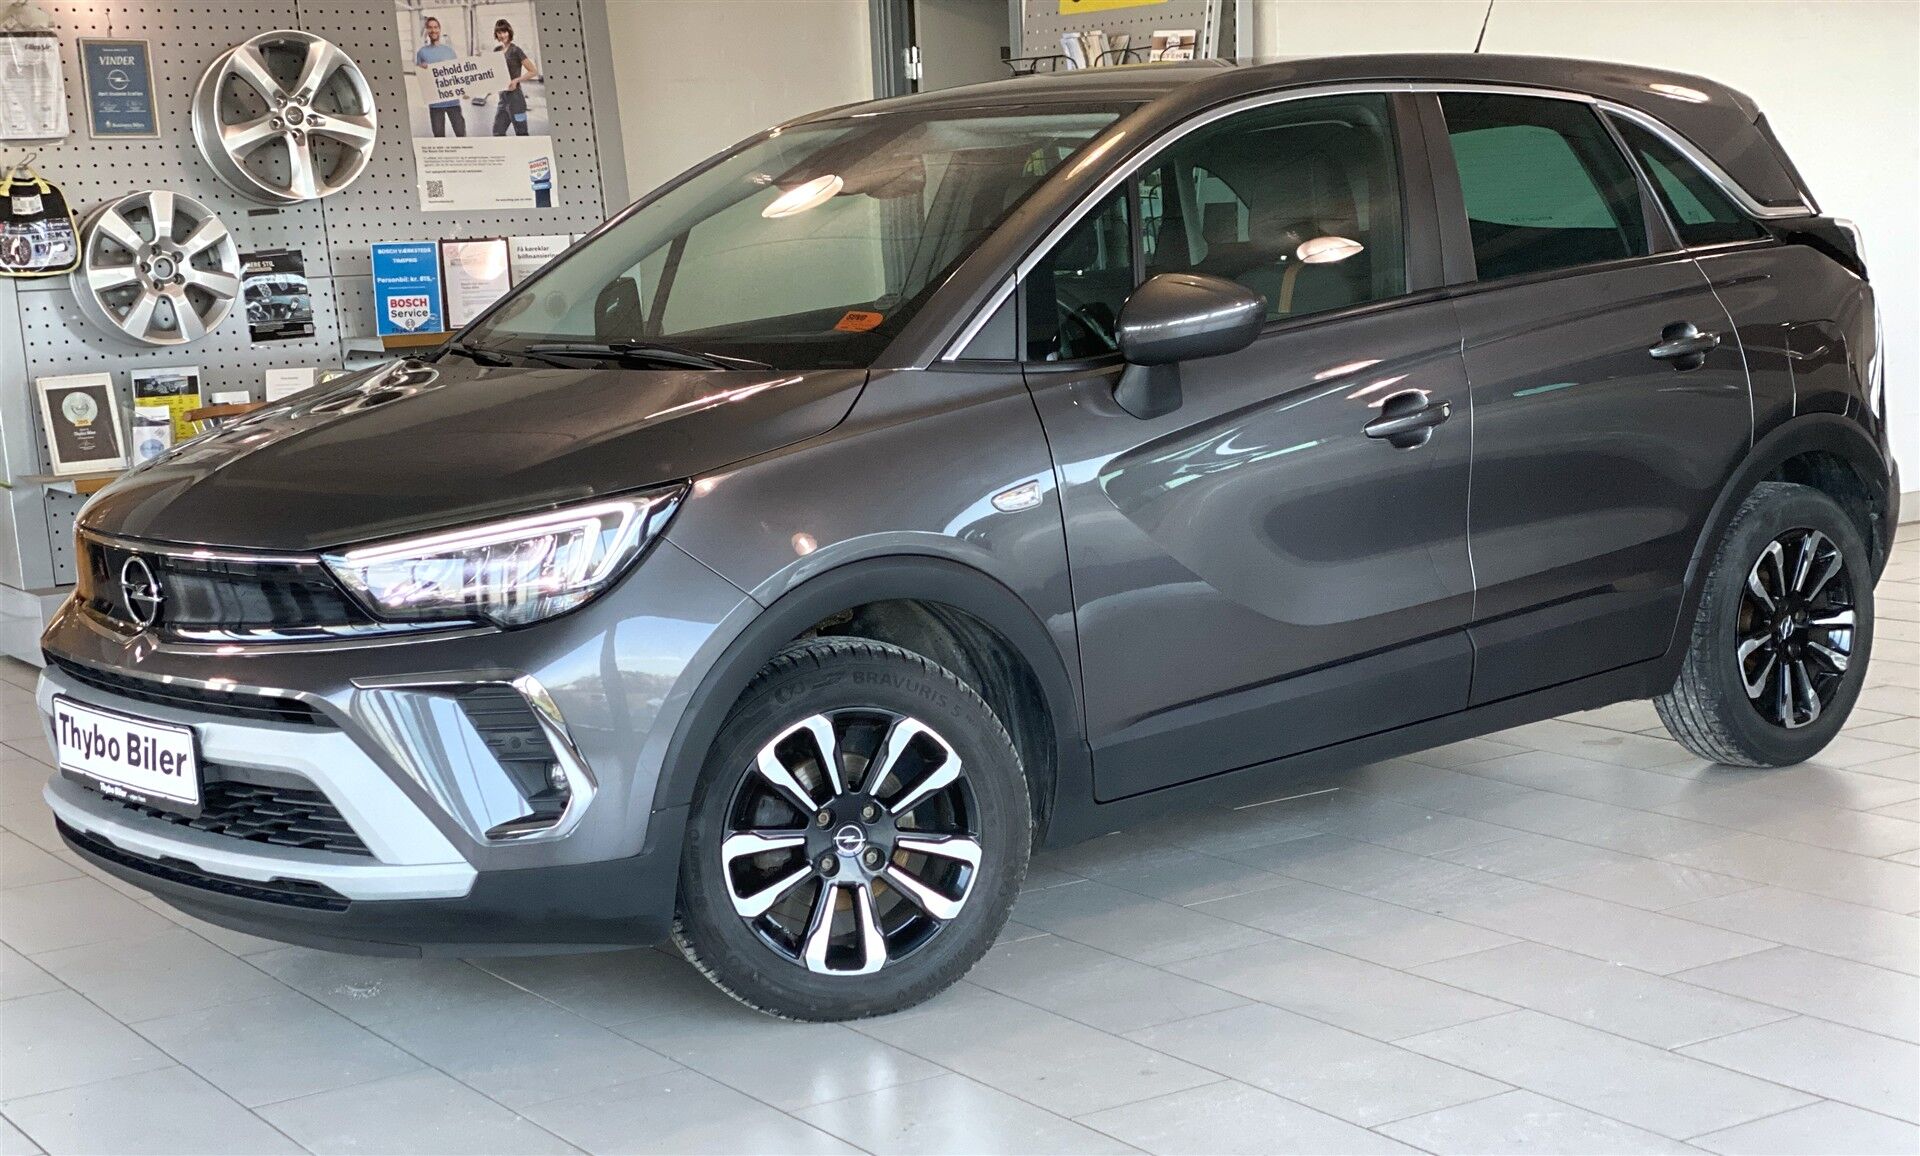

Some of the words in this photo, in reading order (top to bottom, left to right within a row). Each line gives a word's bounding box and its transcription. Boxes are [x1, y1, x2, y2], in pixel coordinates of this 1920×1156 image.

[99, 56, 135, 65] VINDER
[432, 63, 462, 78] Behold
[463, 61, 477, 72] din
[435, 68, 495, 89] fabriksgaranti
[438, 89, 454, 99] hos
[455, 87, 466, 96] os
[390, 298, 428, 308] BOSCH
[391, 310, 429, 318] Service
[852, 671, 947, 708] BRAVURIS
[59, 712, 121, 762] Thybo
[126, 732, 187, 778] Biler
